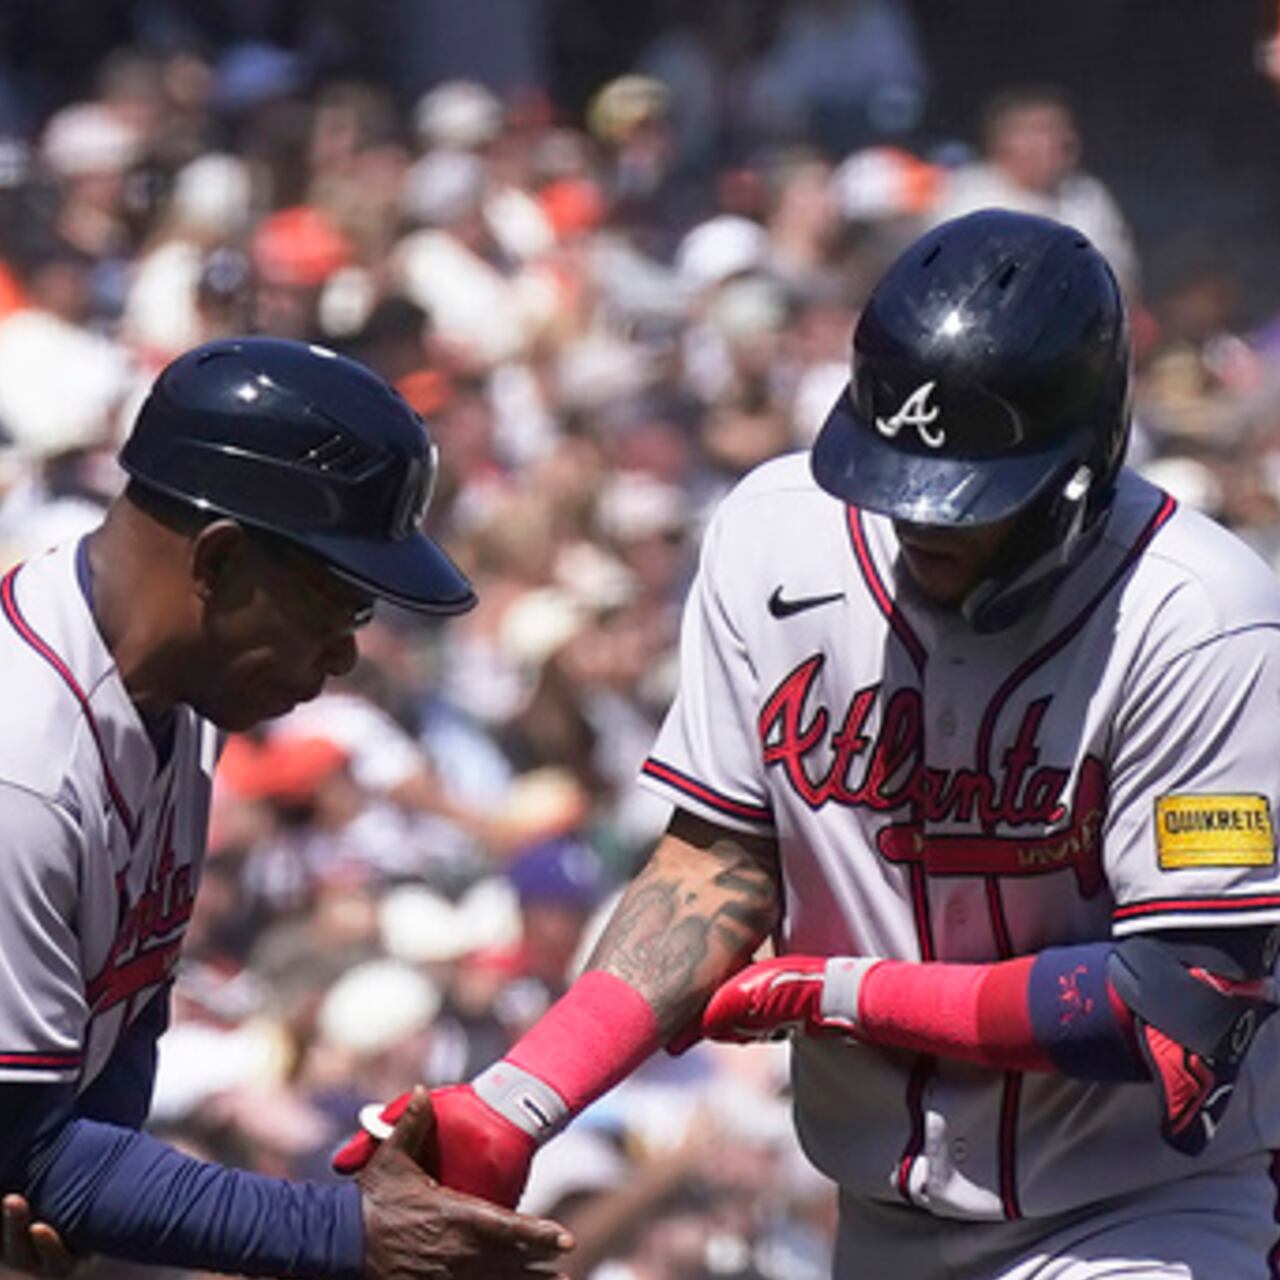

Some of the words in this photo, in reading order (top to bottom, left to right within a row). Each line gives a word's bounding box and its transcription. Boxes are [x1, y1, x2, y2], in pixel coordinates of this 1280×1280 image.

[875, 381, 945, 448] A
[758, 653, 1069, 825] Atlanta
[1165, 808, 1267, 834] QUIKRETE
